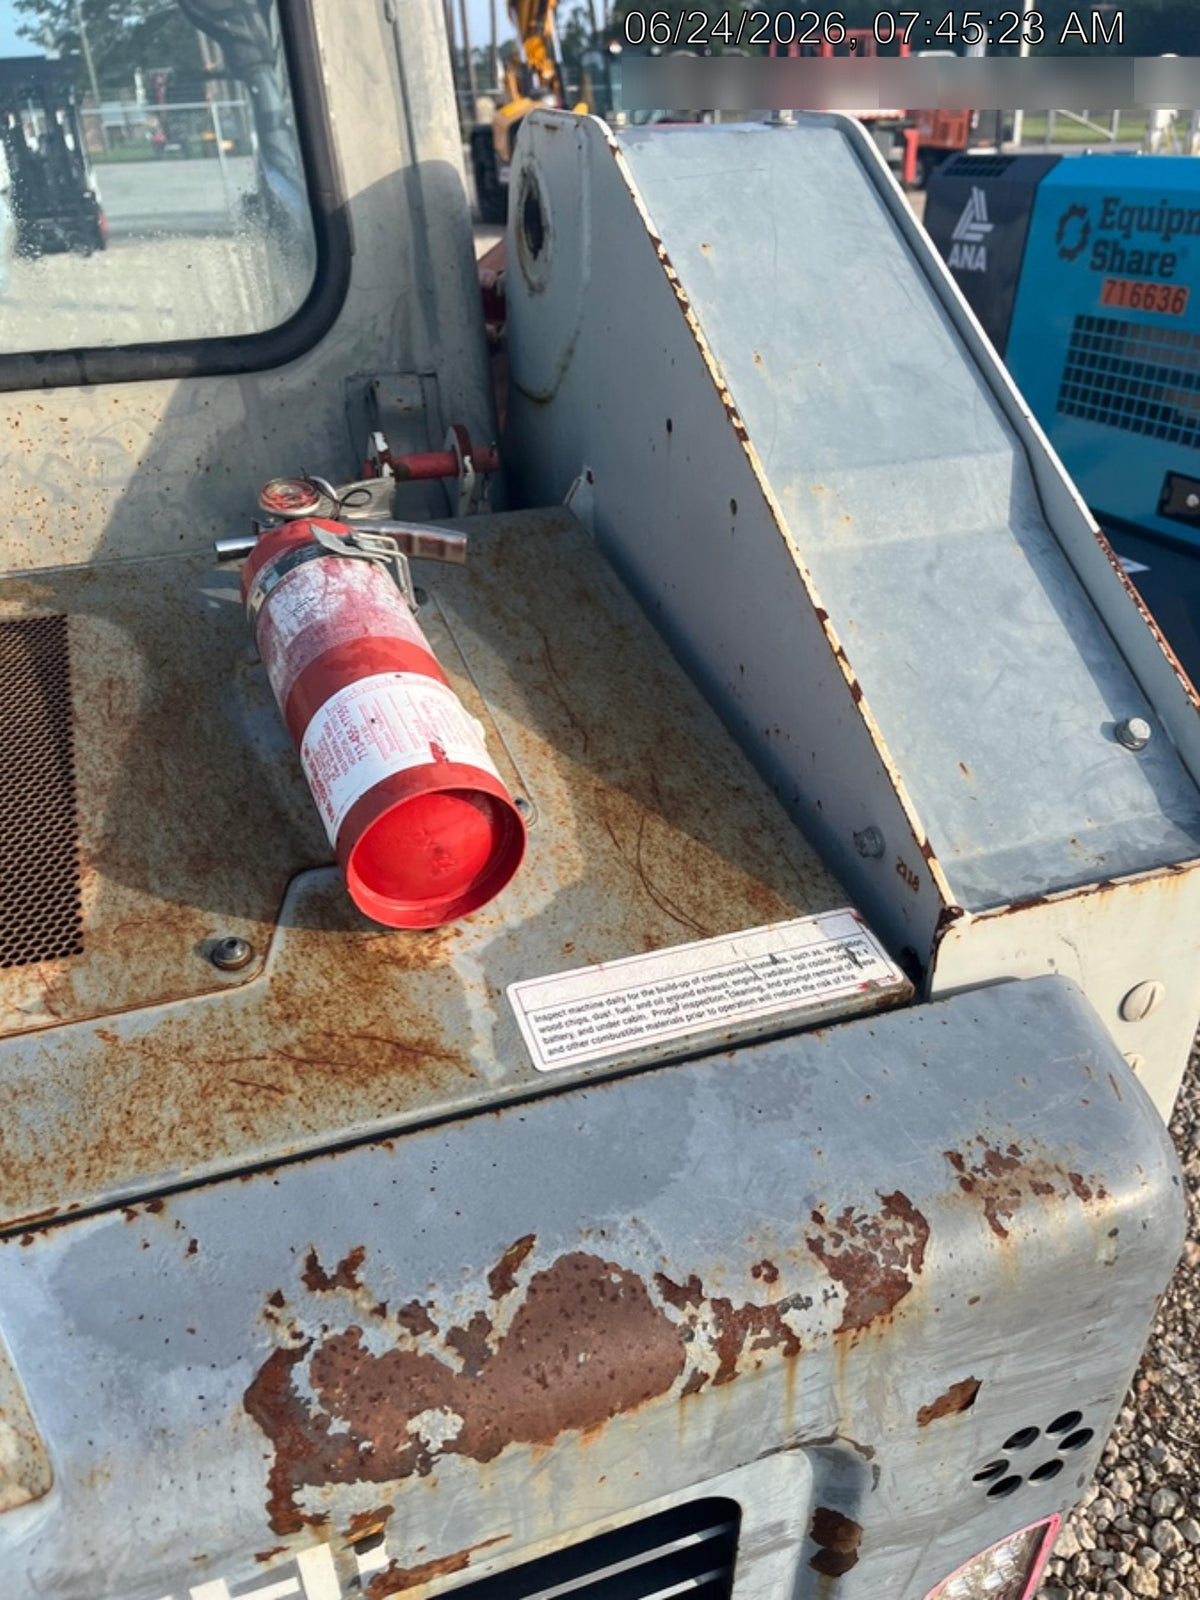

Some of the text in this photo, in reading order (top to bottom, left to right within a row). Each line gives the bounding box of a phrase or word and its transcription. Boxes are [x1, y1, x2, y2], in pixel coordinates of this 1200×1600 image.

[948, 243, 988, 273] ANA
[1089, 239, 1178, 279] Share
[1103, 278, 1189, 315] 716636
